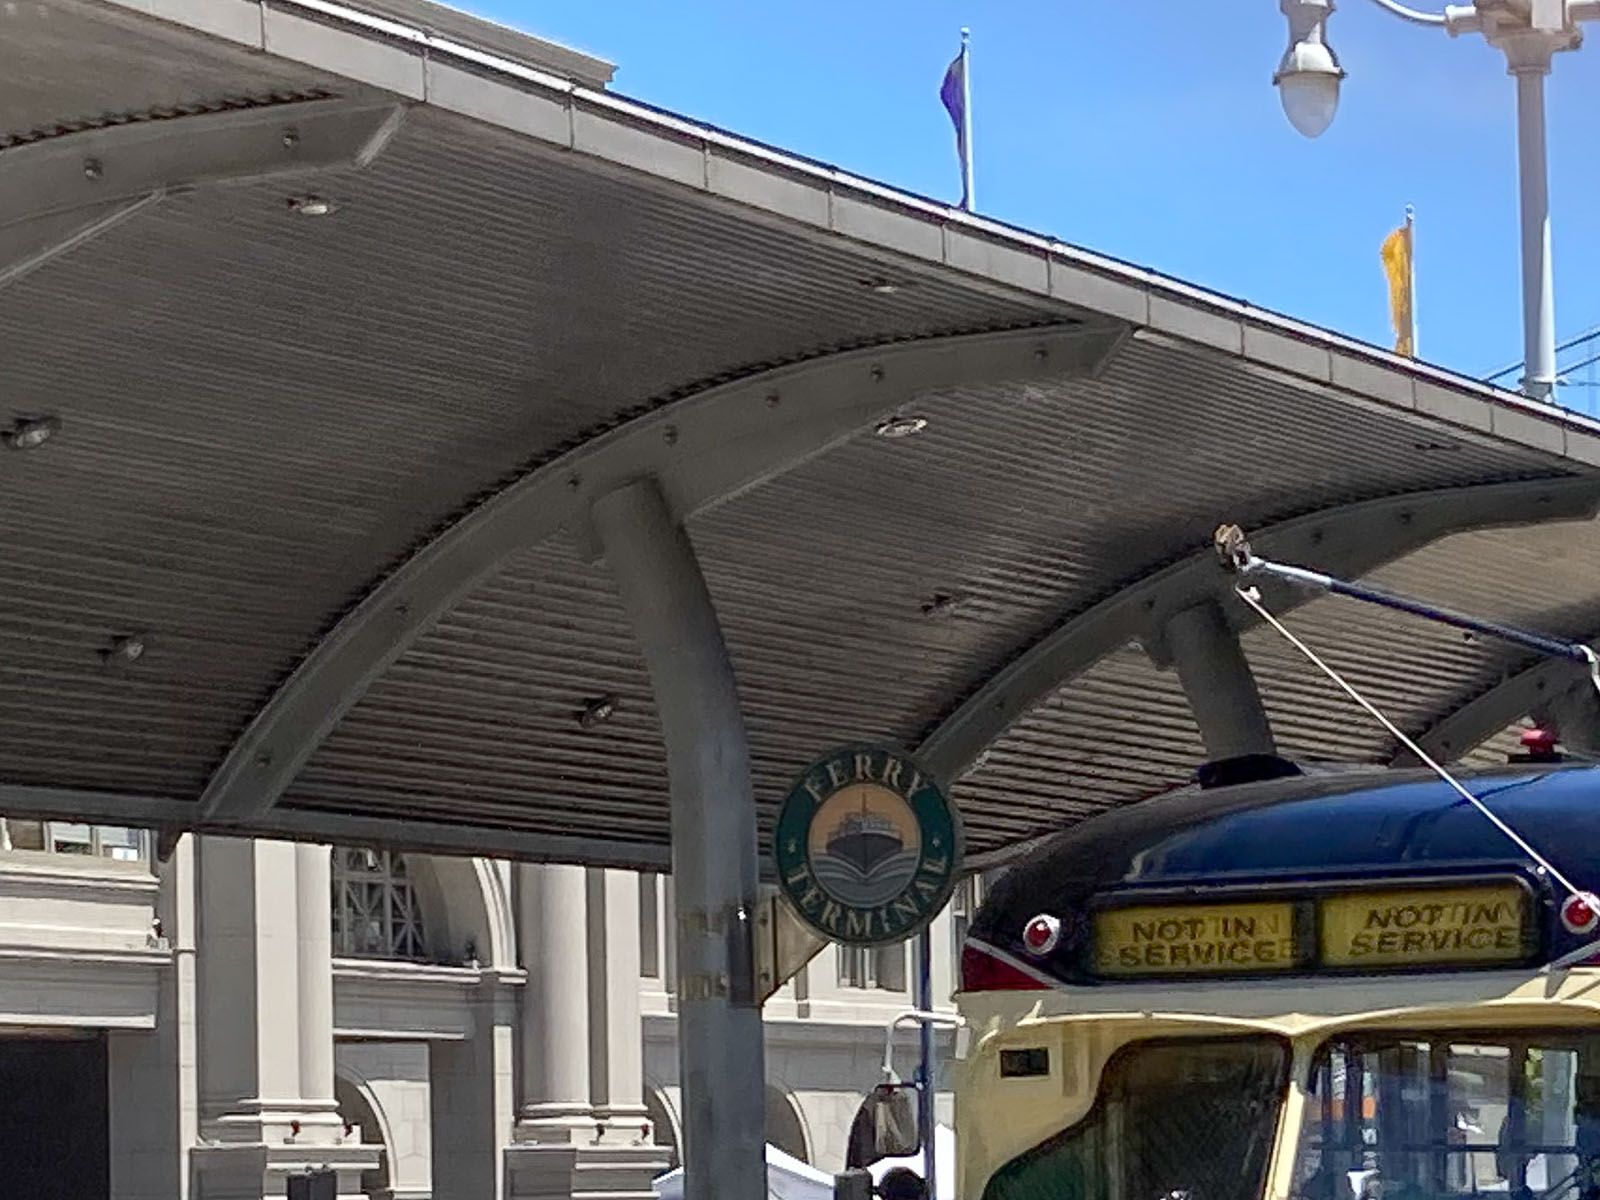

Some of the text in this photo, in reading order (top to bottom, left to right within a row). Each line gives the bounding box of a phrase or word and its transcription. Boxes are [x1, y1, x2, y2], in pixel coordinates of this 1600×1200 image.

[804, 753, 929, 802] FERRY
[787, 856, 947, 937] TERMINAL
[1132, 916, 1257, 943] NOT IN
[1364, 902, 1501, 929] NOT IN
[1118, 940, 1277, 967] SERVICE
[1348, 927, 1518, 956] SERVICE
